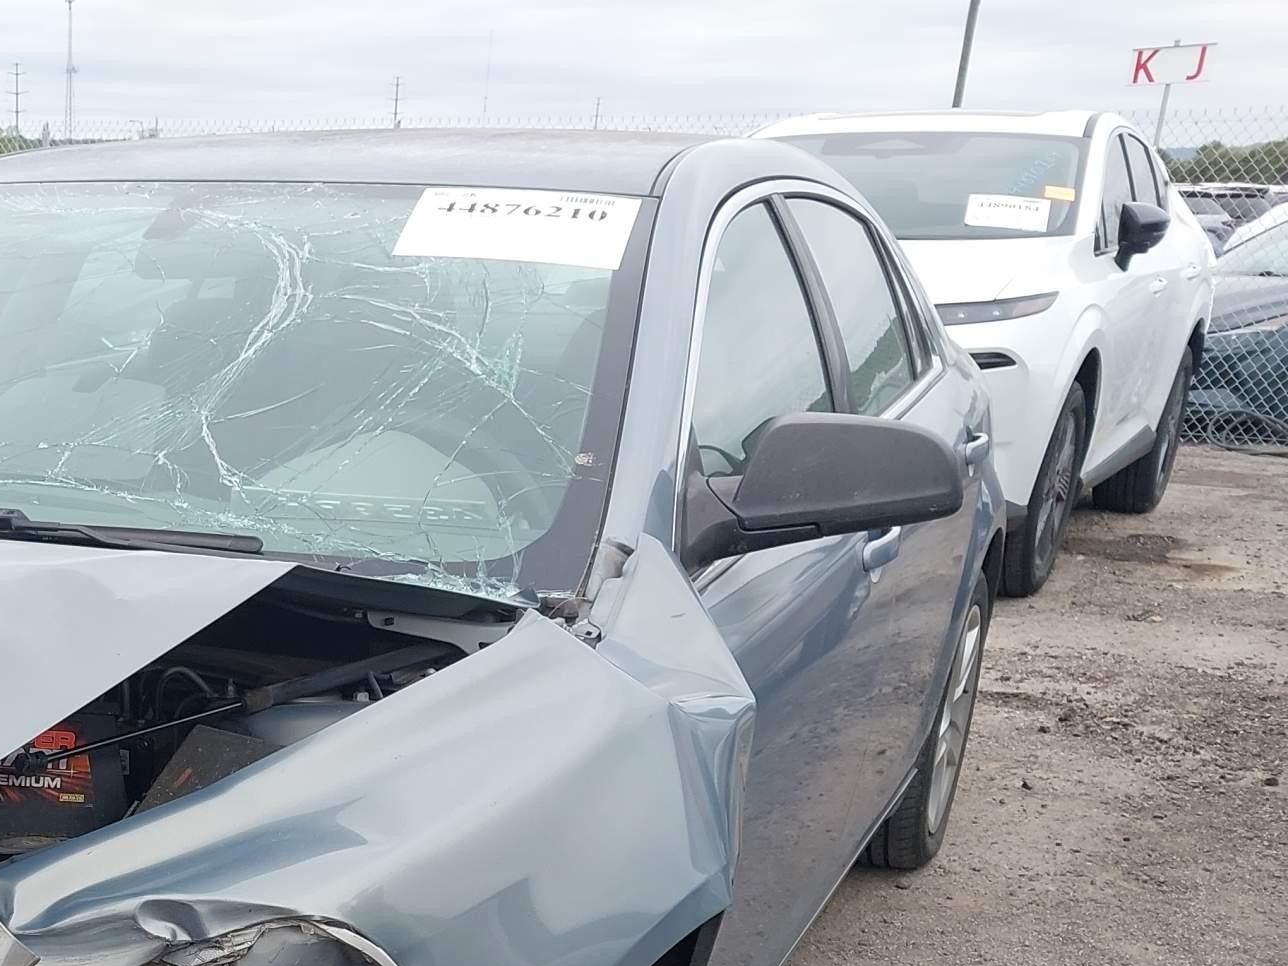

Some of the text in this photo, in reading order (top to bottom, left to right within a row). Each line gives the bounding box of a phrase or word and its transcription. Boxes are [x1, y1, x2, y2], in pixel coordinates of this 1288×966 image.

[1132, 45, 1208, 84] K J
[437, 201, 608, 221] 44876210
